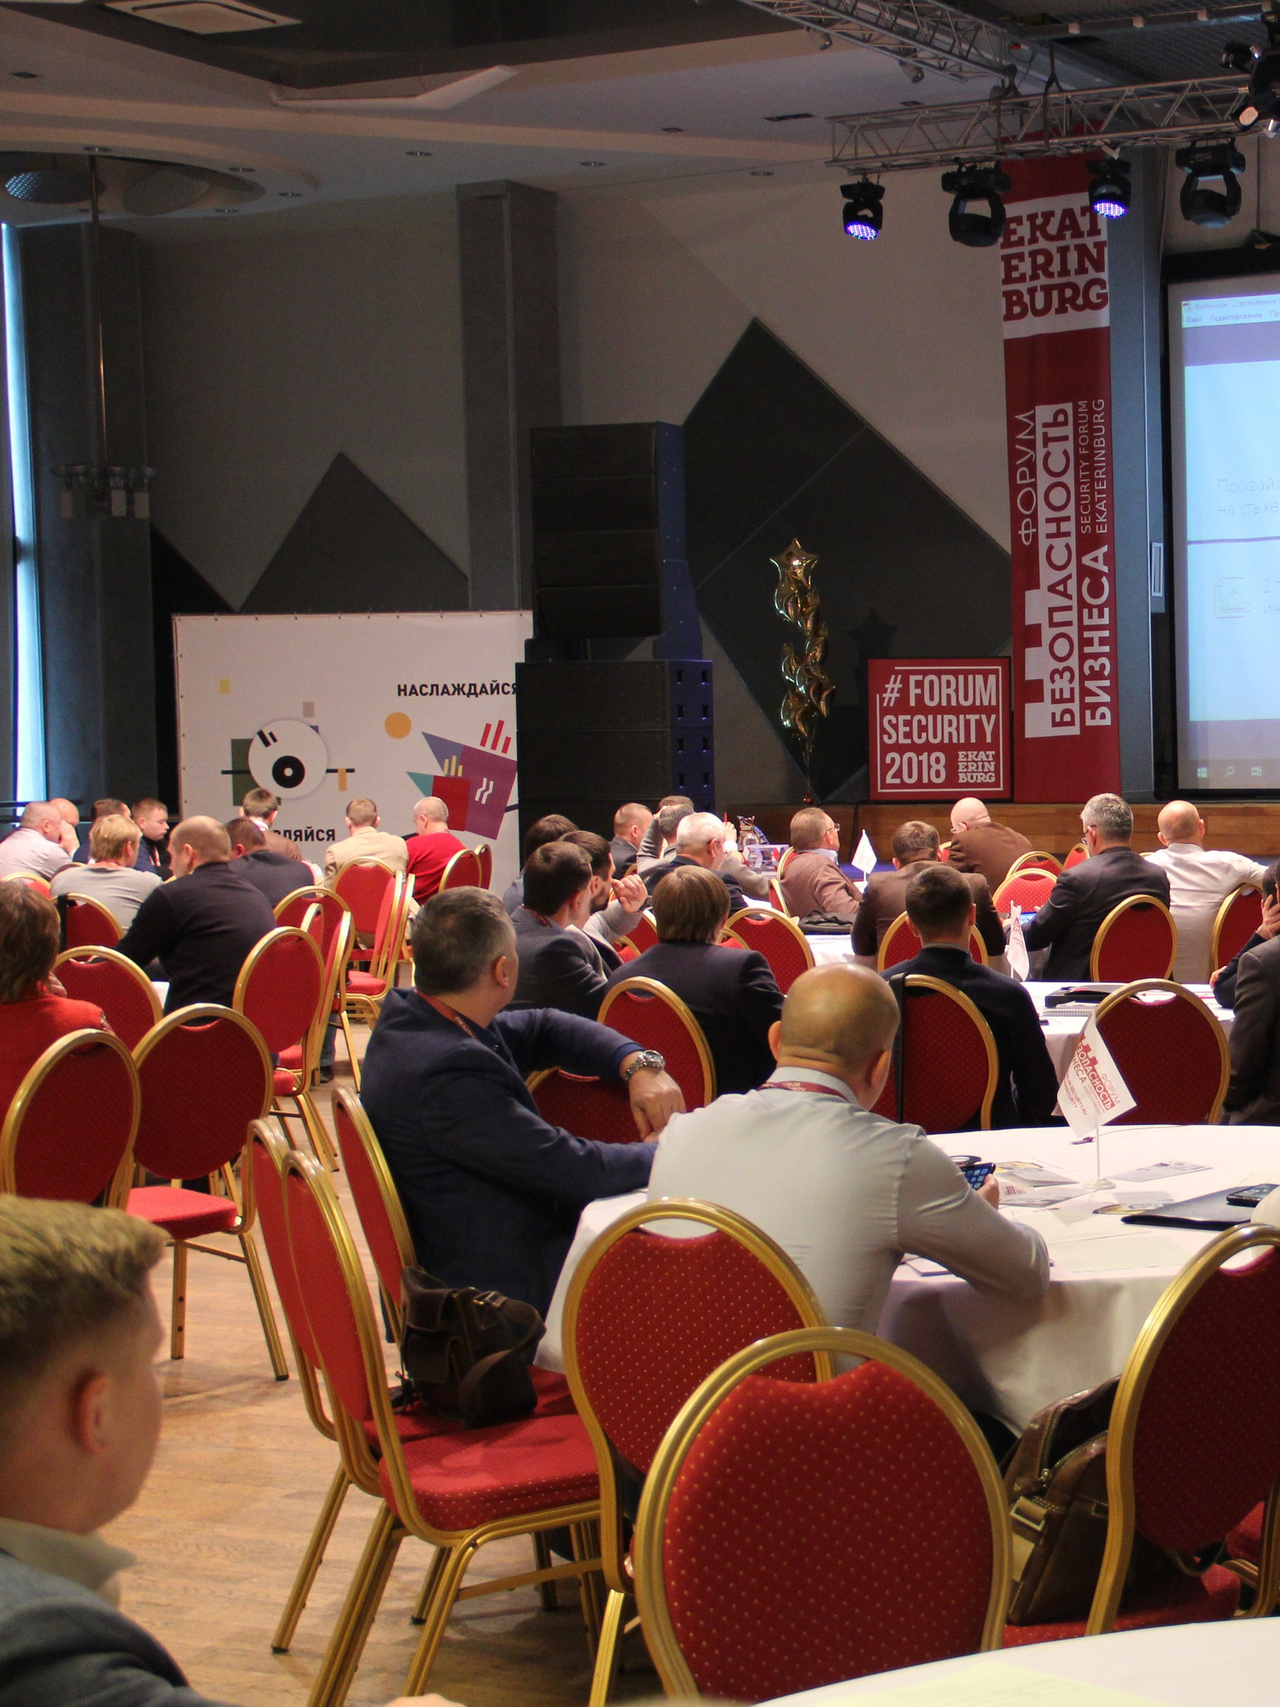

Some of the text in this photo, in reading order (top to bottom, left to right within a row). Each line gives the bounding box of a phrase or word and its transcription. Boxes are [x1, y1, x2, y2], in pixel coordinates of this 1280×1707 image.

[1001, 205, 1102, 249] EKAT
[1001, 241, 1107, 286] ERIN
[1002, 278, 1109, 322] BURG
[1014, 409, 1036, 546] ФОРУМ
[1077, 400, 1092, 534] SECURITY FORUM
[1091, 398, 1108, 534] EKATERINBURG
[1042, 406, 1076, 729] БЕЗОПАСНОСТЬ
[1081, 544, 1112, 727] БИЗНЕСА
[882, 714, 997, 744] SECURITY
[885, 751, 947, 784] 2018
[957, 751, 996, 762] EKAT
[957, 762, 996, 773] ERIN
[957, 773, 996, 783] BURG
[1076, 1042, 1112, 1110] ЗОПАСНОСТЬ
